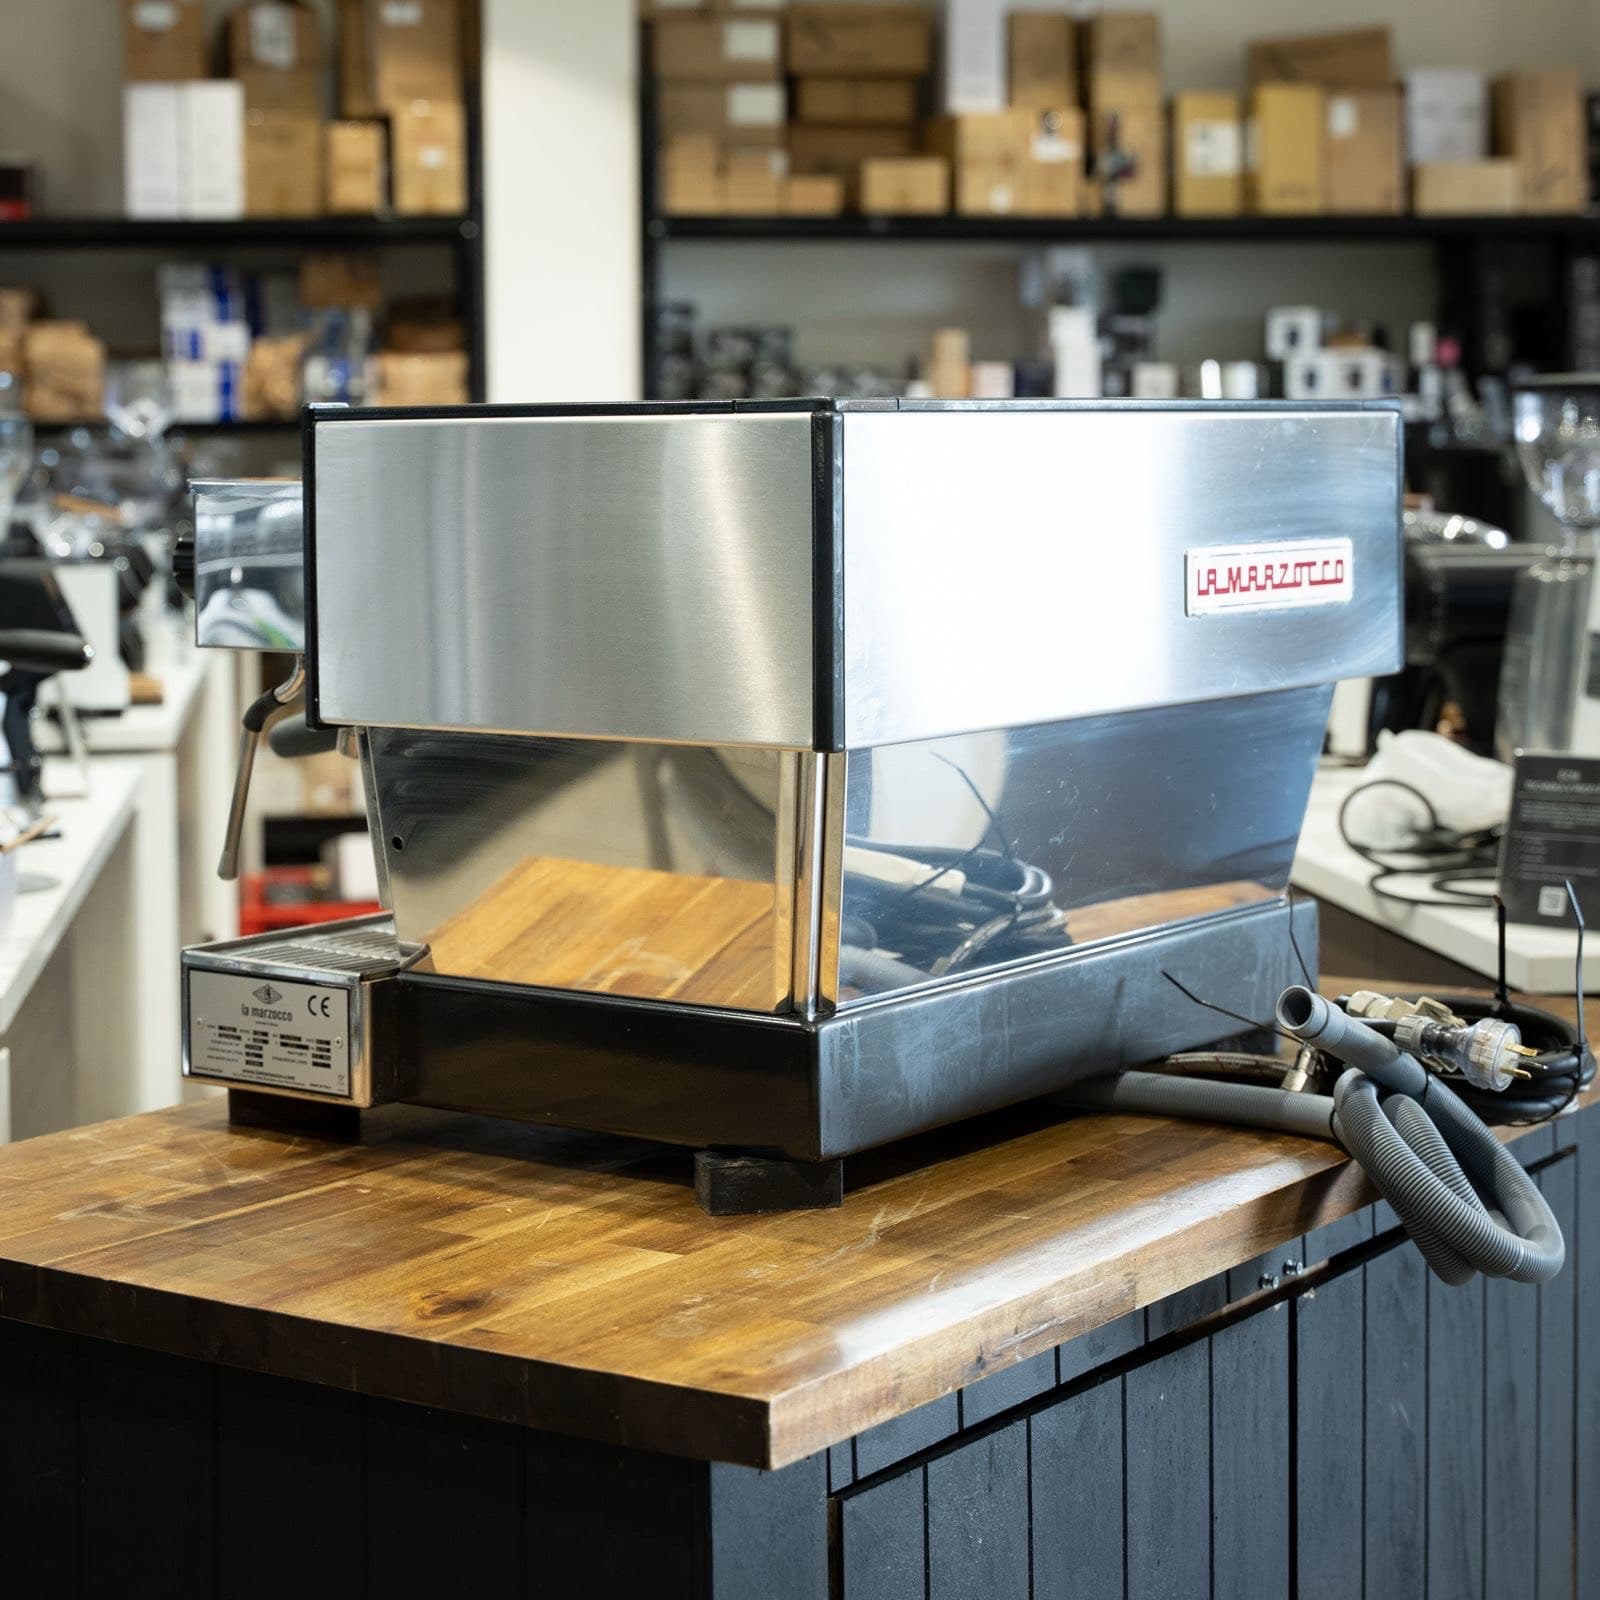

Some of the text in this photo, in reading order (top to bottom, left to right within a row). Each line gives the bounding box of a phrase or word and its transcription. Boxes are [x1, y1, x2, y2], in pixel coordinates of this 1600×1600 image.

[241, 1003, 293, 1022] la marzocco
[307, 995, 330, 1018] CE
